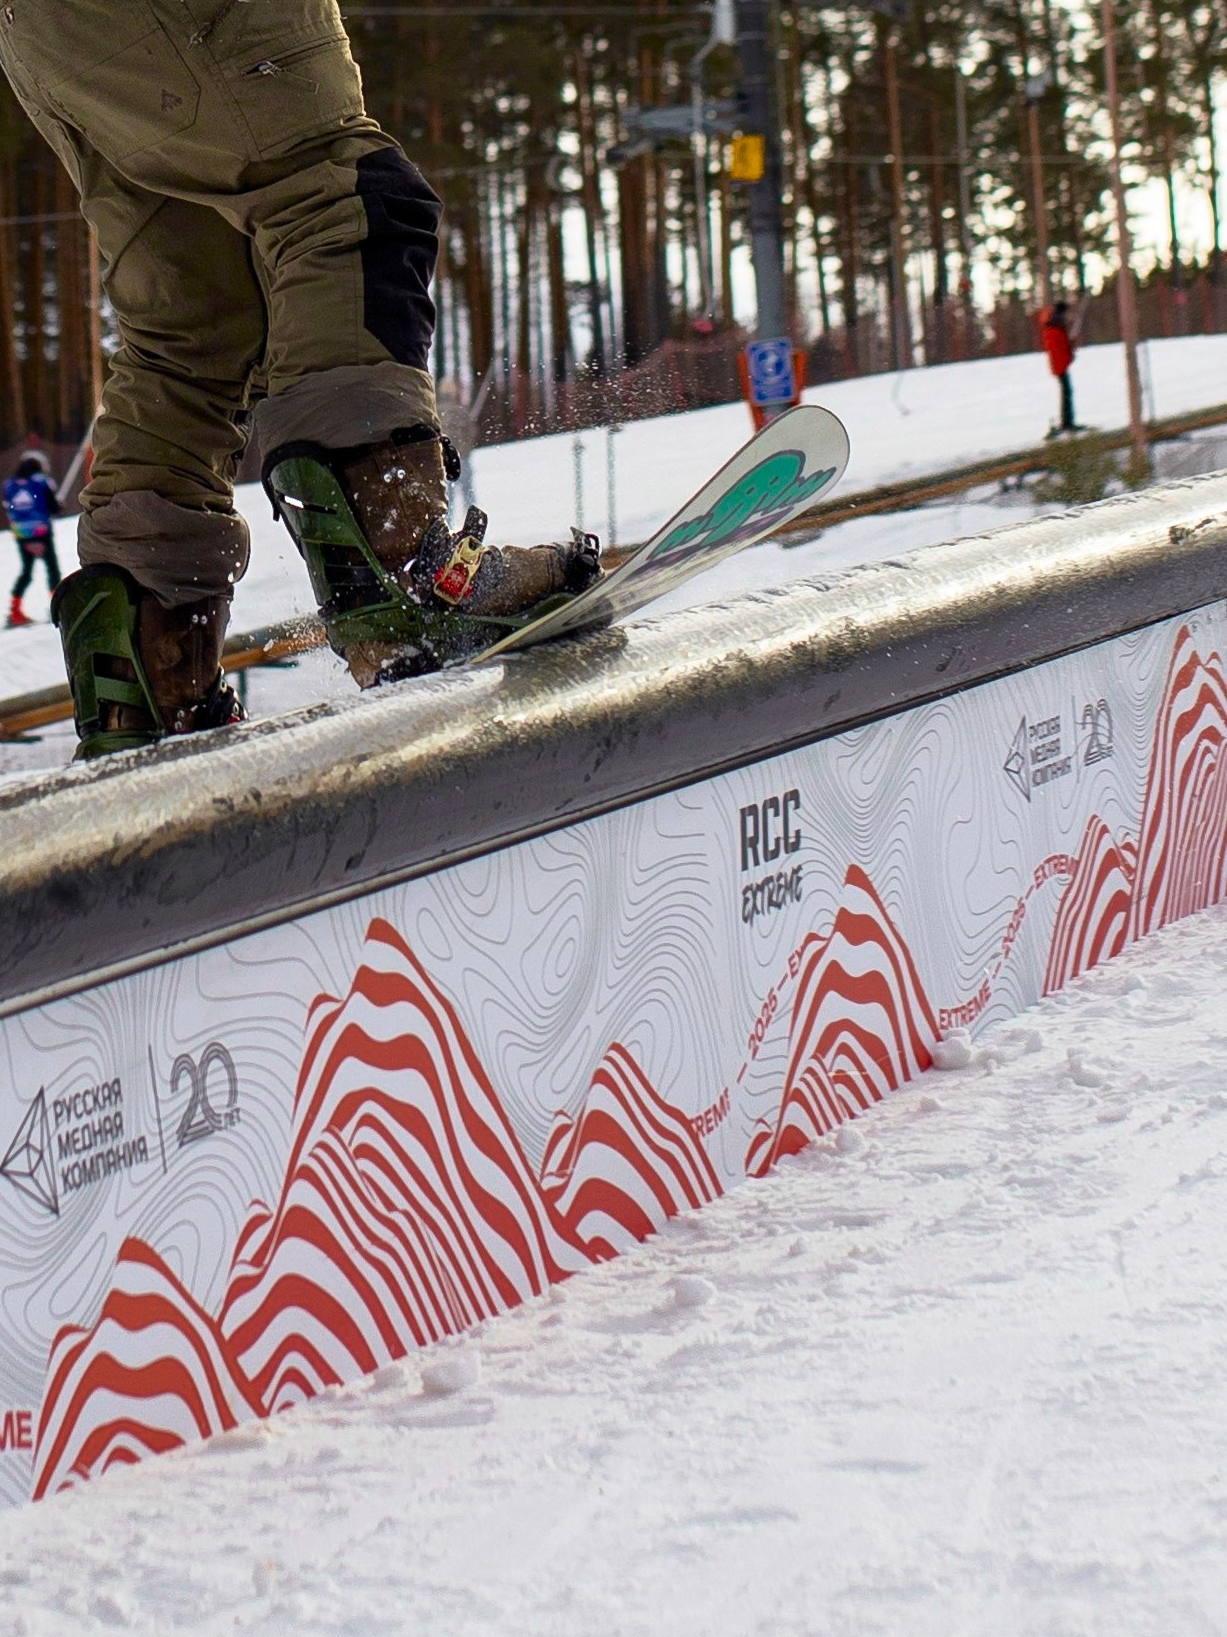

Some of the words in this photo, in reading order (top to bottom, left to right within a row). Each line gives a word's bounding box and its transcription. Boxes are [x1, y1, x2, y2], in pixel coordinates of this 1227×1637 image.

[739, 789, 801, 871] RCC
[742, 865, 803, 927] EXTREME
[748, 988, 777, 1060] 2025
[53, 1077, 123, 1129] РУССКАЯ
[170, 1042, 238, 1149] 20
[58, 1111, 124, 1160] МЕДНАЯ
[61, 1135, 149, 1197] КОМПАНИЯ
